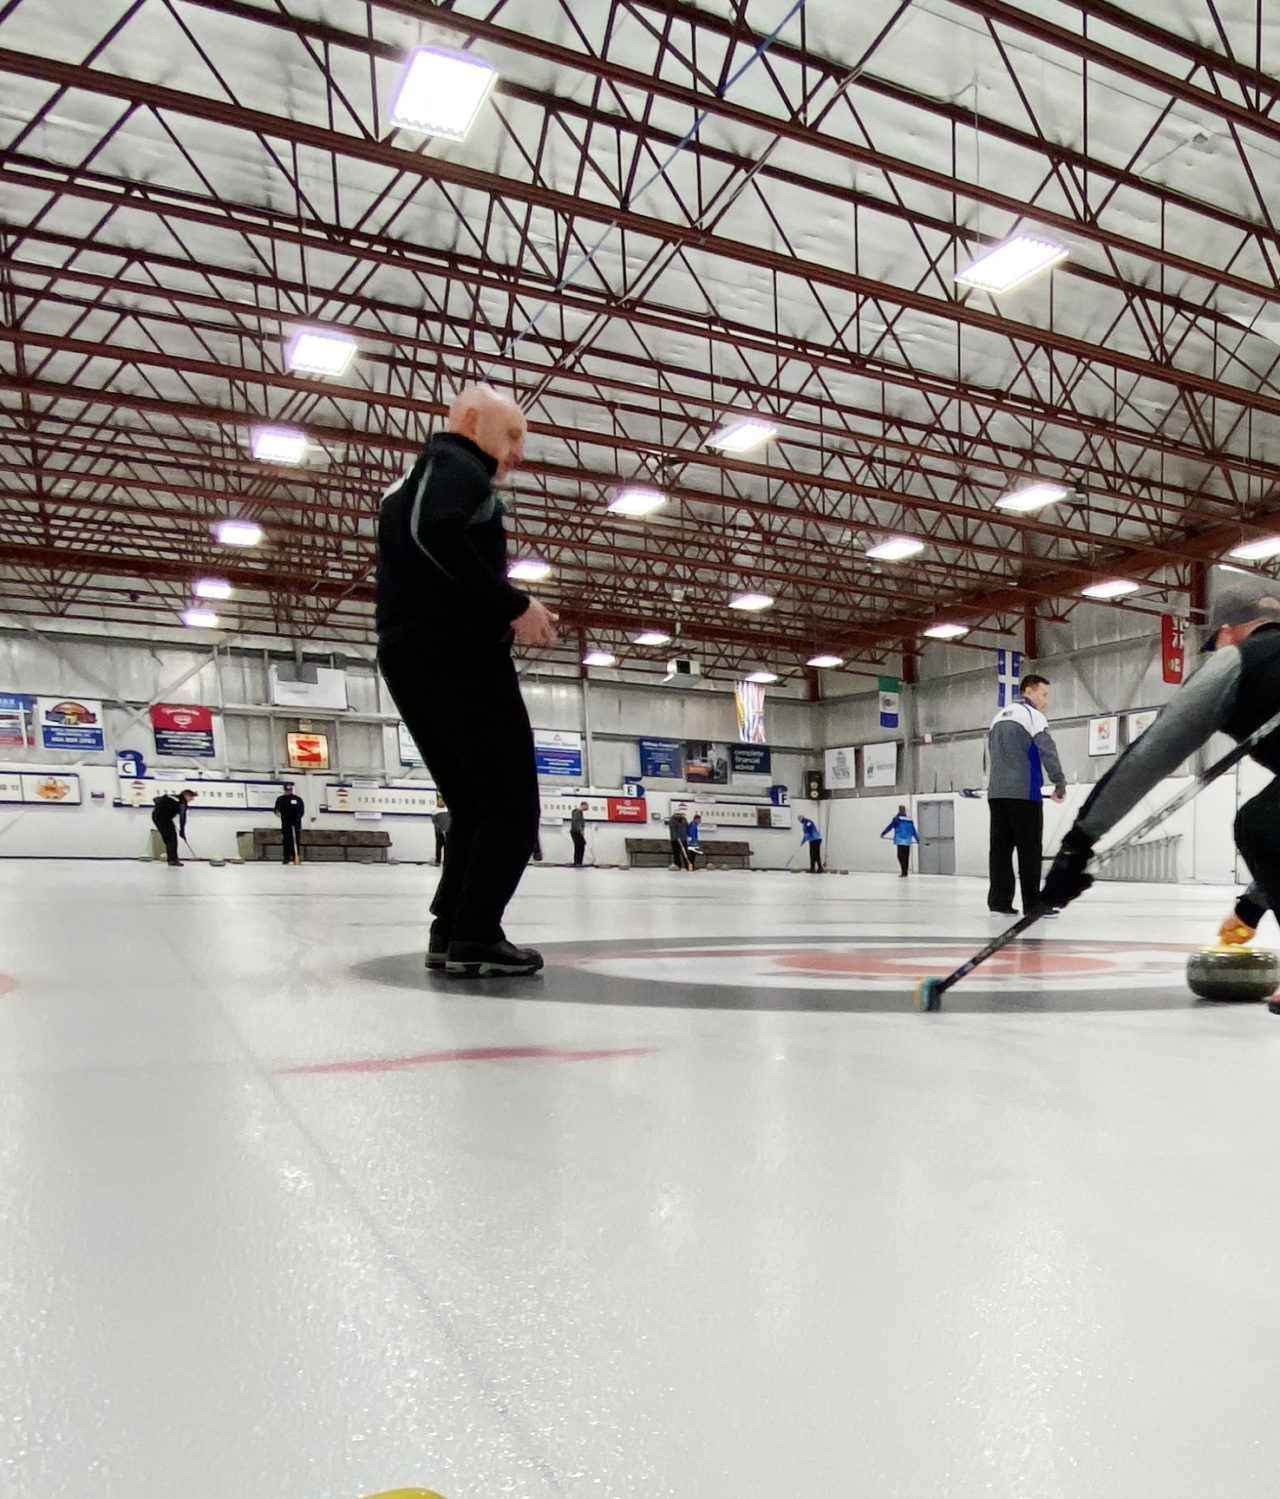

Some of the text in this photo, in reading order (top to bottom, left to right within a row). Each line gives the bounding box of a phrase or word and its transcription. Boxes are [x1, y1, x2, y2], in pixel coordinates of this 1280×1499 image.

[122, 763, 132, 773] C
[627, 786, 635, 796] E
[781, 793, 788, 804] F
